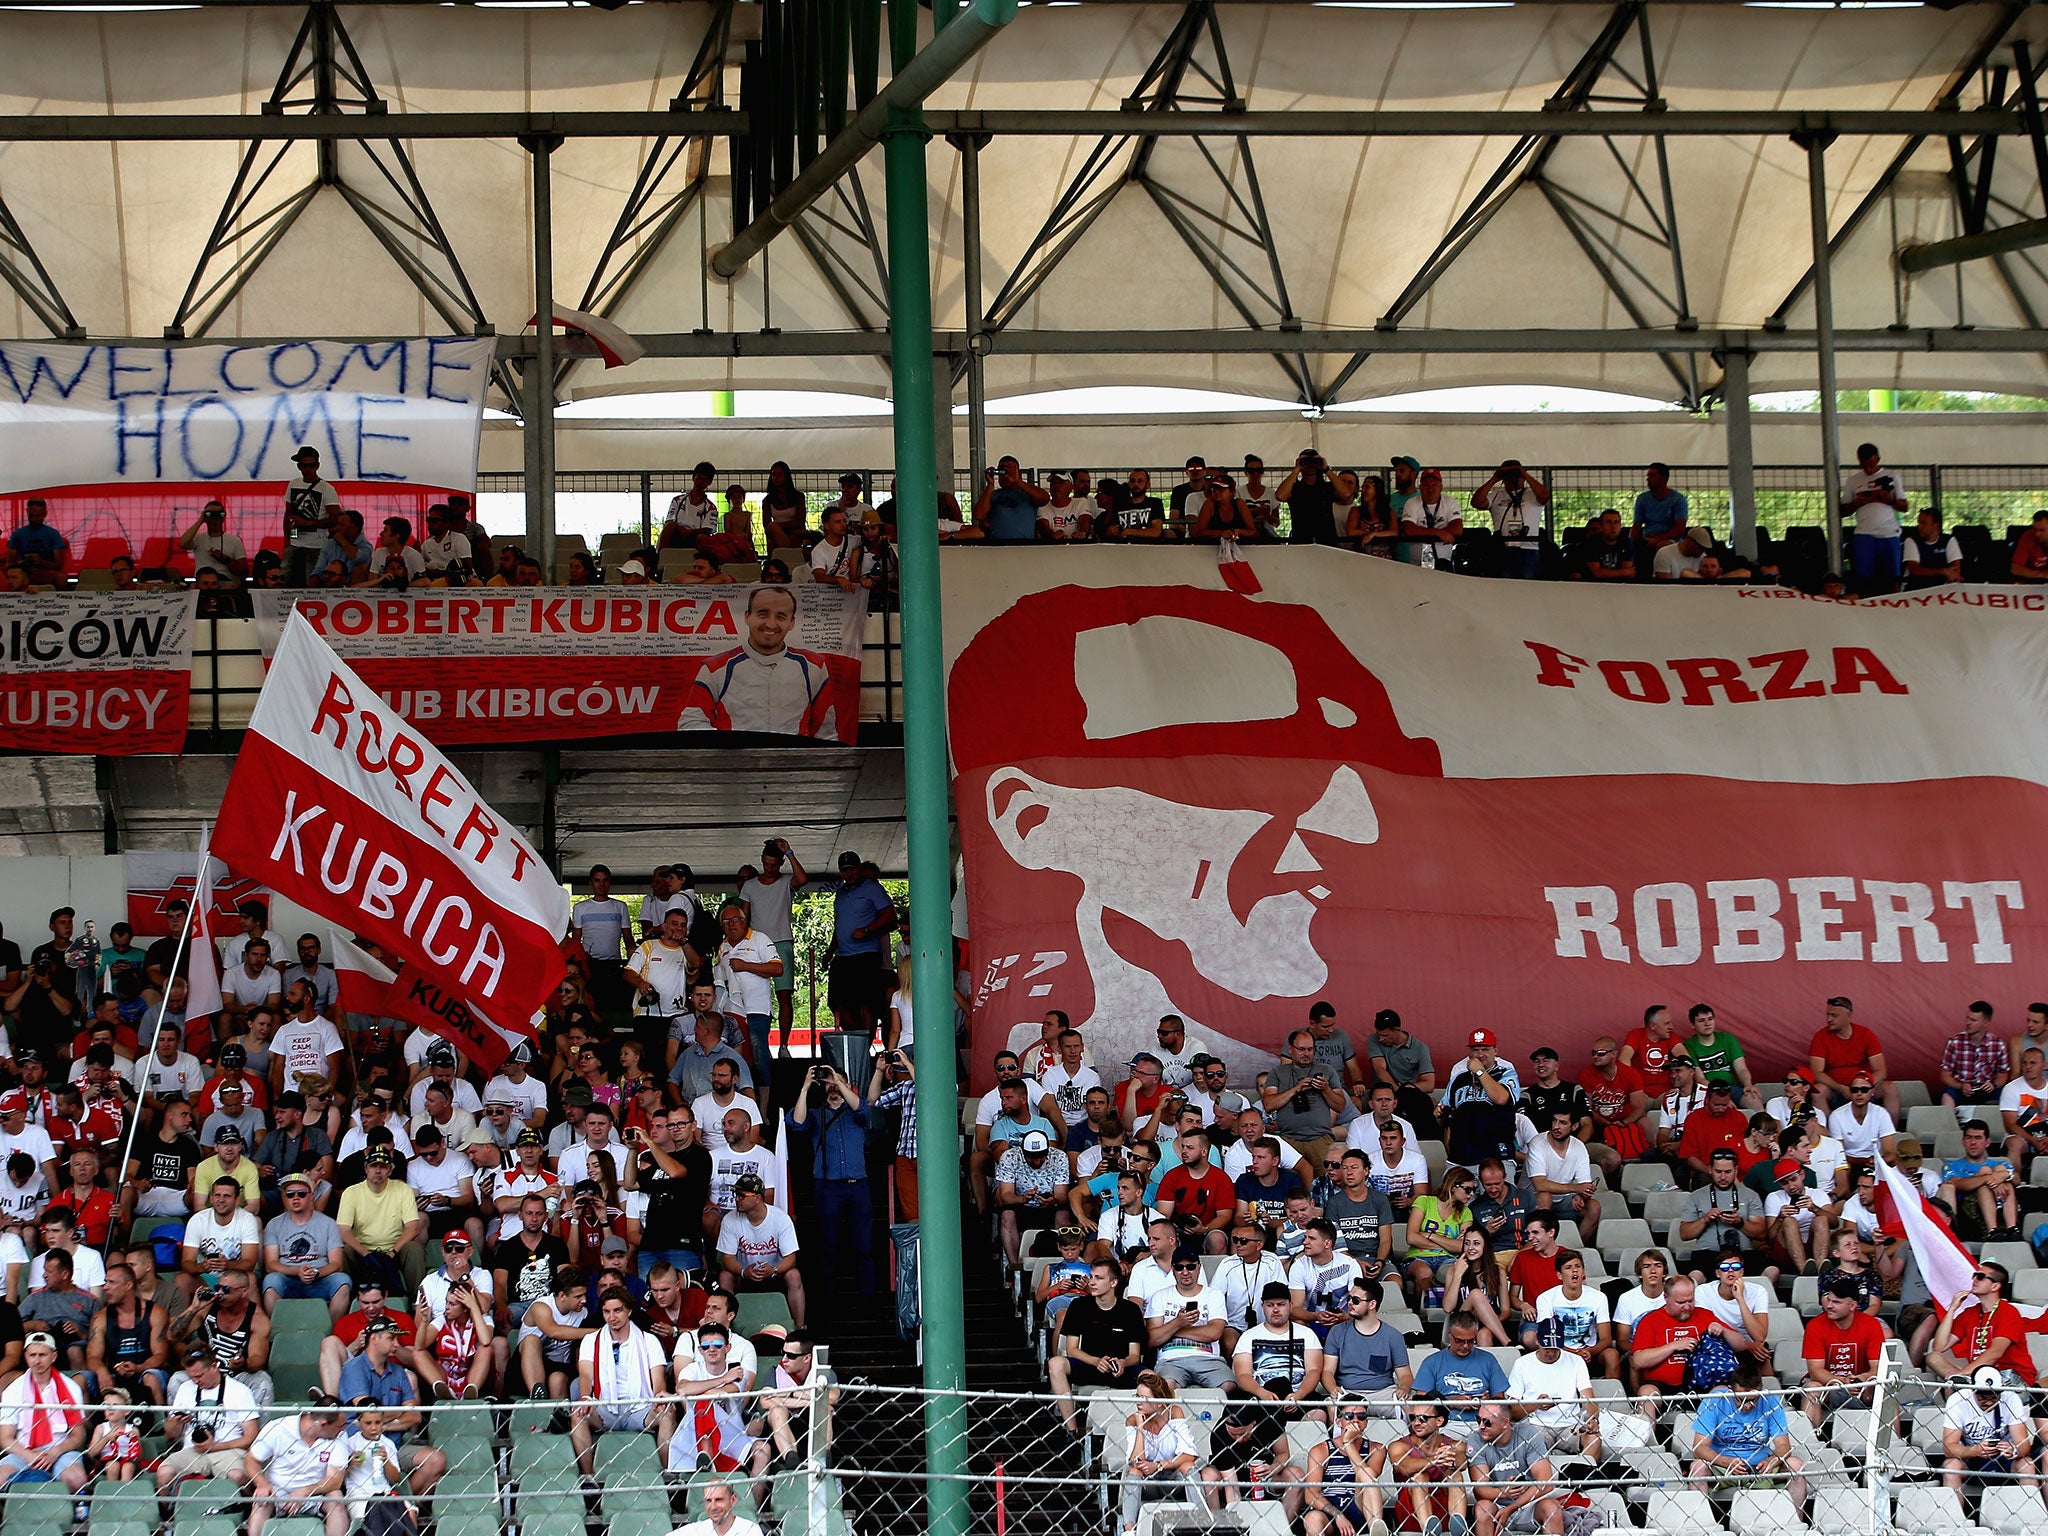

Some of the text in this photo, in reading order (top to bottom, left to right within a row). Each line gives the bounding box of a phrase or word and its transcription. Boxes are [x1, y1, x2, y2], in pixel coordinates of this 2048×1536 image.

[0, 337, 473, 403] WELCOME
[116, 391, 410, 480] HOME
[1118, 511, 1150, 529] NEW
[0, 609, 168, 662] ICÓW
[296, 598, 738, 635] ROBERT KUBICA
[1523, 640, 1909, 706] FORZA
[0, 688, 168, 730] UBICY
[381, 681, 660, 720] UB KIBICÓW
[310, 670, 536, 882] ROBERT
[270, 790, 506, 998] KUBICA
[1544, 876, 2024, 966] ROBERT
[289, 1053, 319, 1061] SUPPORT
[292, 1036, 312, 1044] KEEP
[155, 1168, 176, 1177] USA
[157, 1157, 177, 1166] NYC
[1339, 1219, 1359, 1227] MOJE
